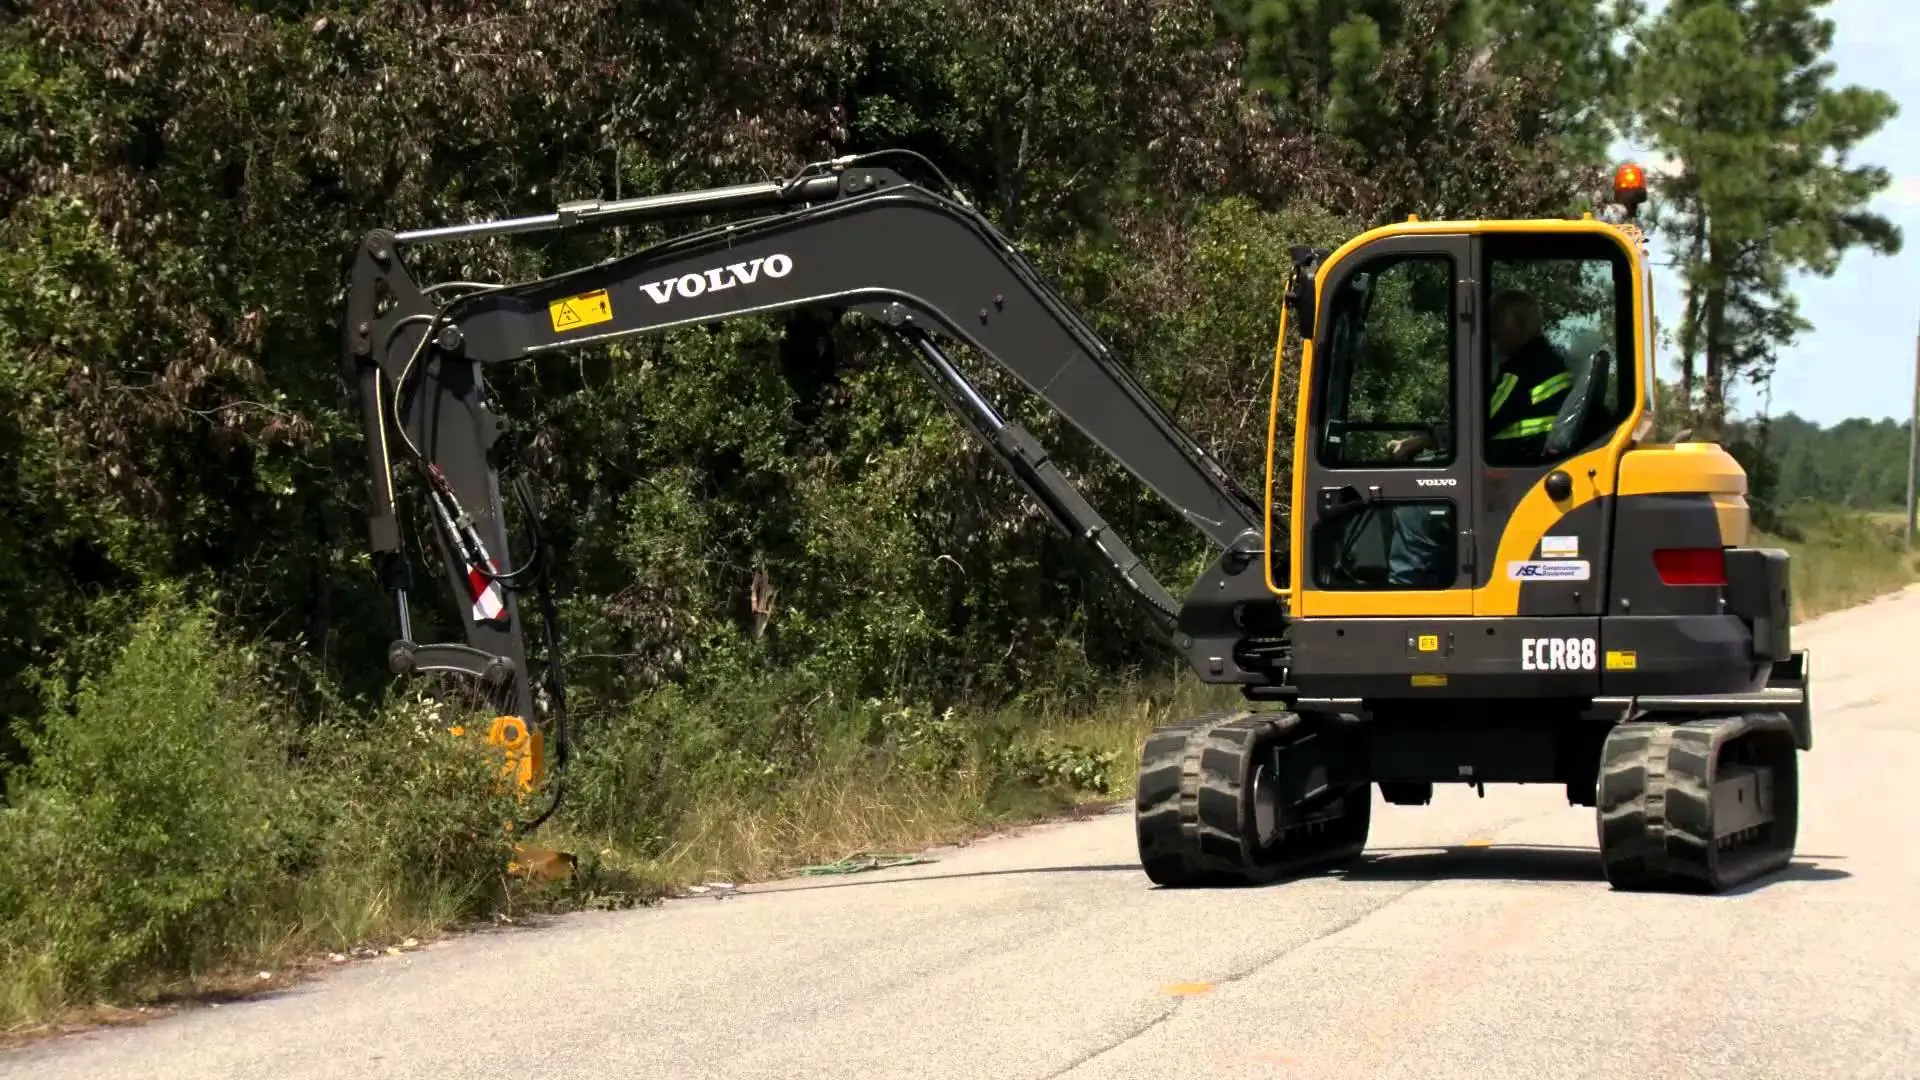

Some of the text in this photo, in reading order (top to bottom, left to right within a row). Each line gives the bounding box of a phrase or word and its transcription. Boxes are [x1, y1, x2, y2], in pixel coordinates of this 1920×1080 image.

[640, 253, 793, 305] VOLVO
[1416, 479, 1457, 487] VOLVO
[1522, 638, 1596, 670] ECR88
